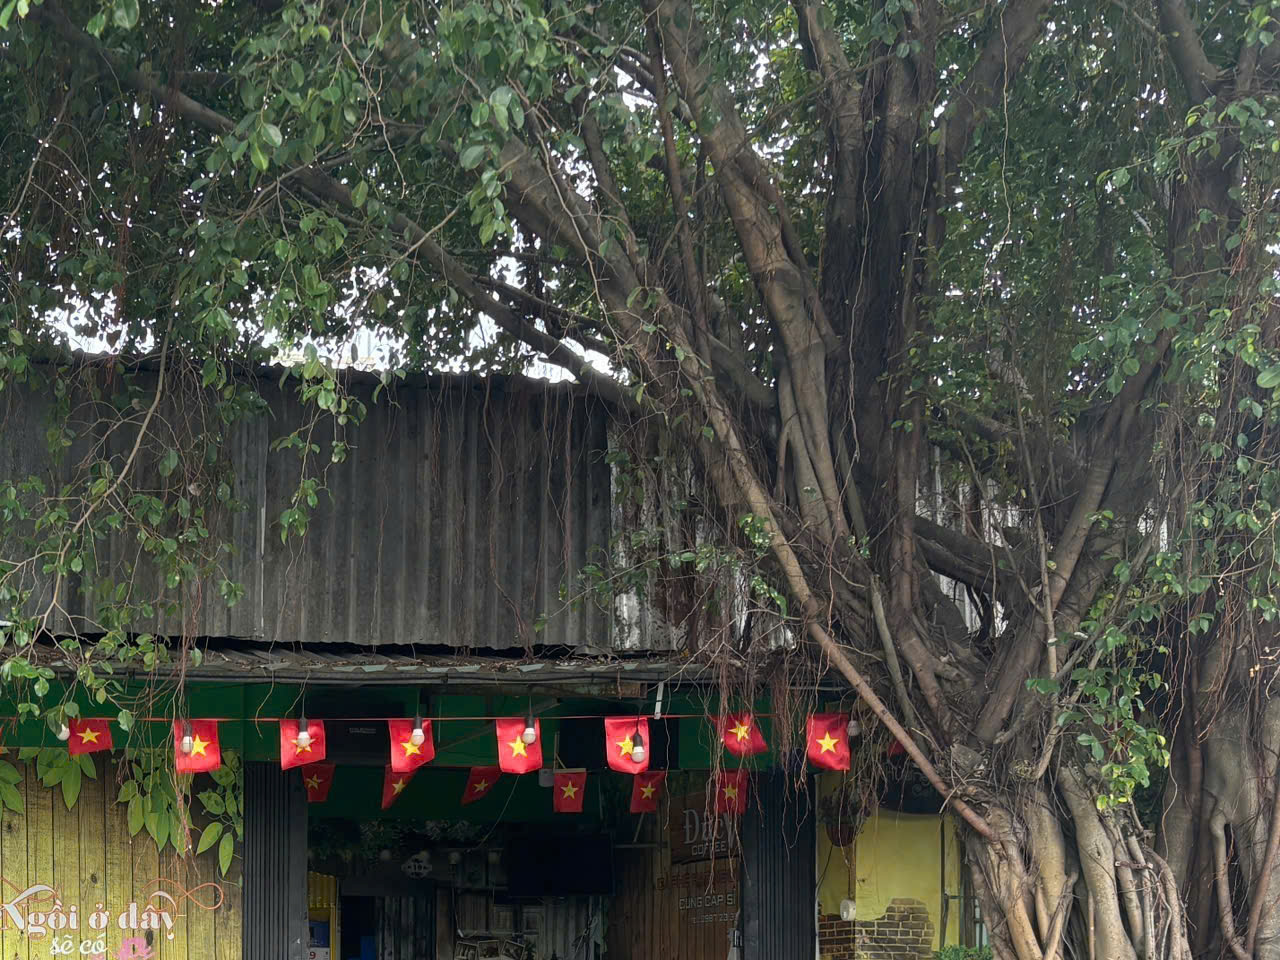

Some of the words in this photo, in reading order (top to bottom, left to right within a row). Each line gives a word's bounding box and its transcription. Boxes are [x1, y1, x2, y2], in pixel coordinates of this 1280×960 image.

[89, 903, 110, 930] ở
[50, 934, 75, 955] sẽ
[79, 934, 108, 955] có
